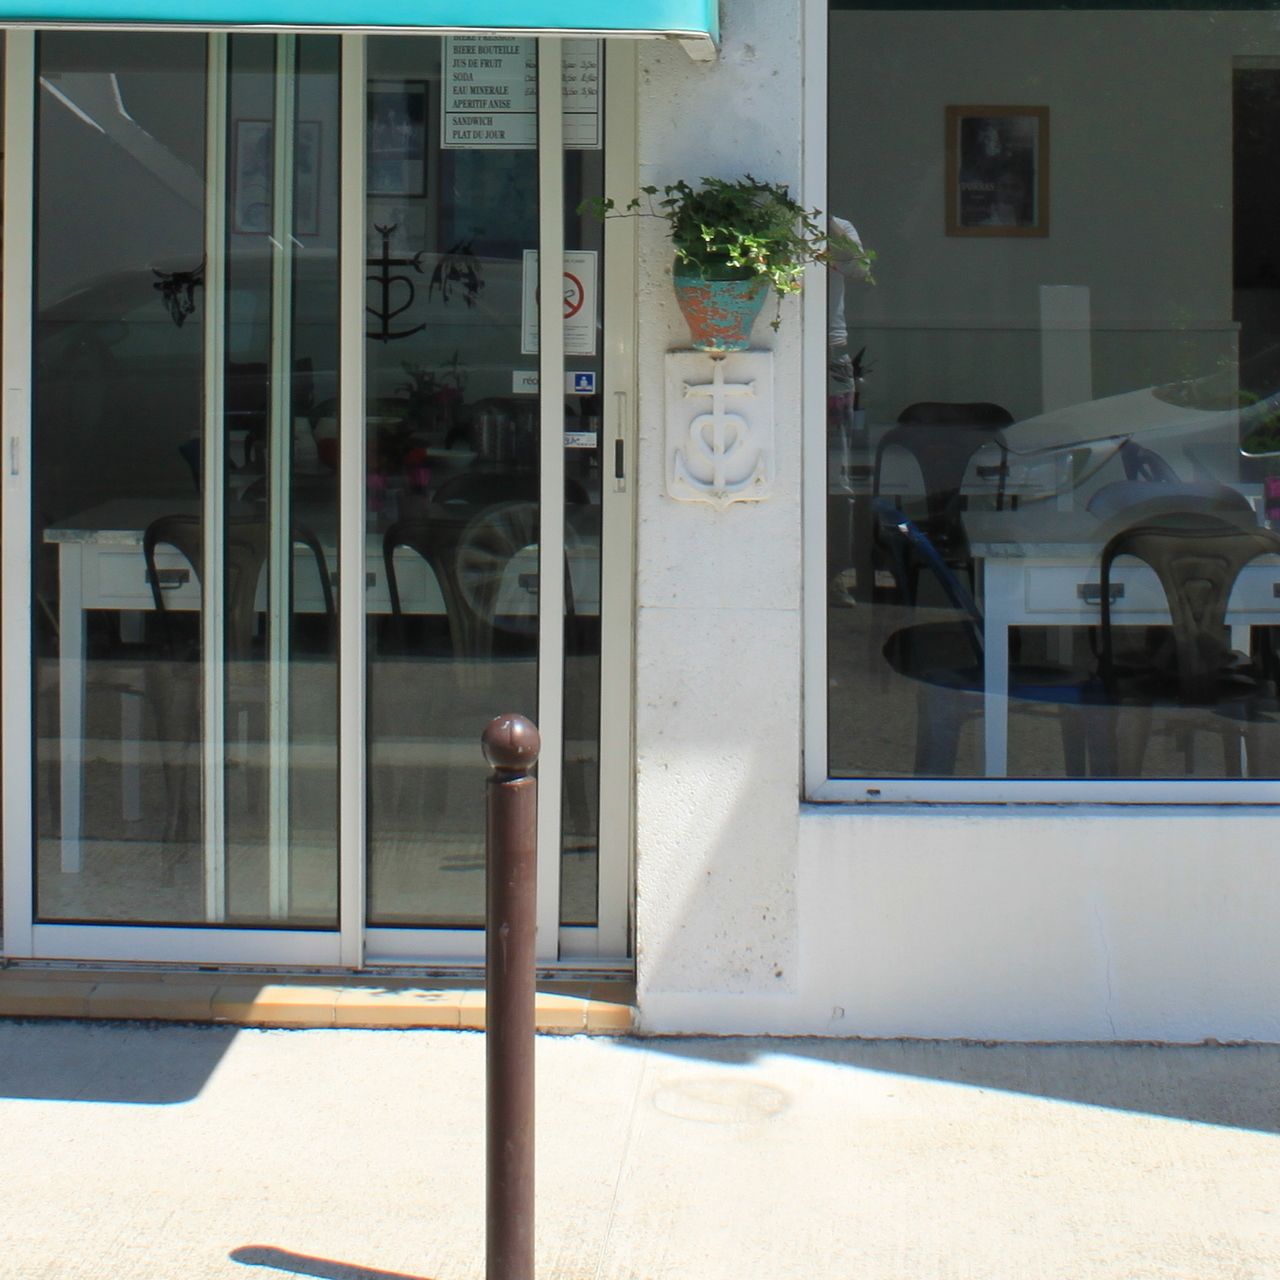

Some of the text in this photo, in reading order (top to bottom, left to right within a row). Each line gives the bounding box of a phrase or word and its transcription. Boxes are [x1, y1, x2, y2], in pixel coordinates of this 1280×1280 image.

[453, 45, 521, 55] BIERE BOUTEILLE
[452, 58, 503, 68] JUS DE FRUIT
[452, 72, 474, 82] SODA
[453, 85, 510, 95] EAU MINERALE
[452, 99, 512, 109] APERITIF ANISE
[452, 116, 493, 126] SANDWICH
[452, 130, 506, 139] PLAT DU JOUR
